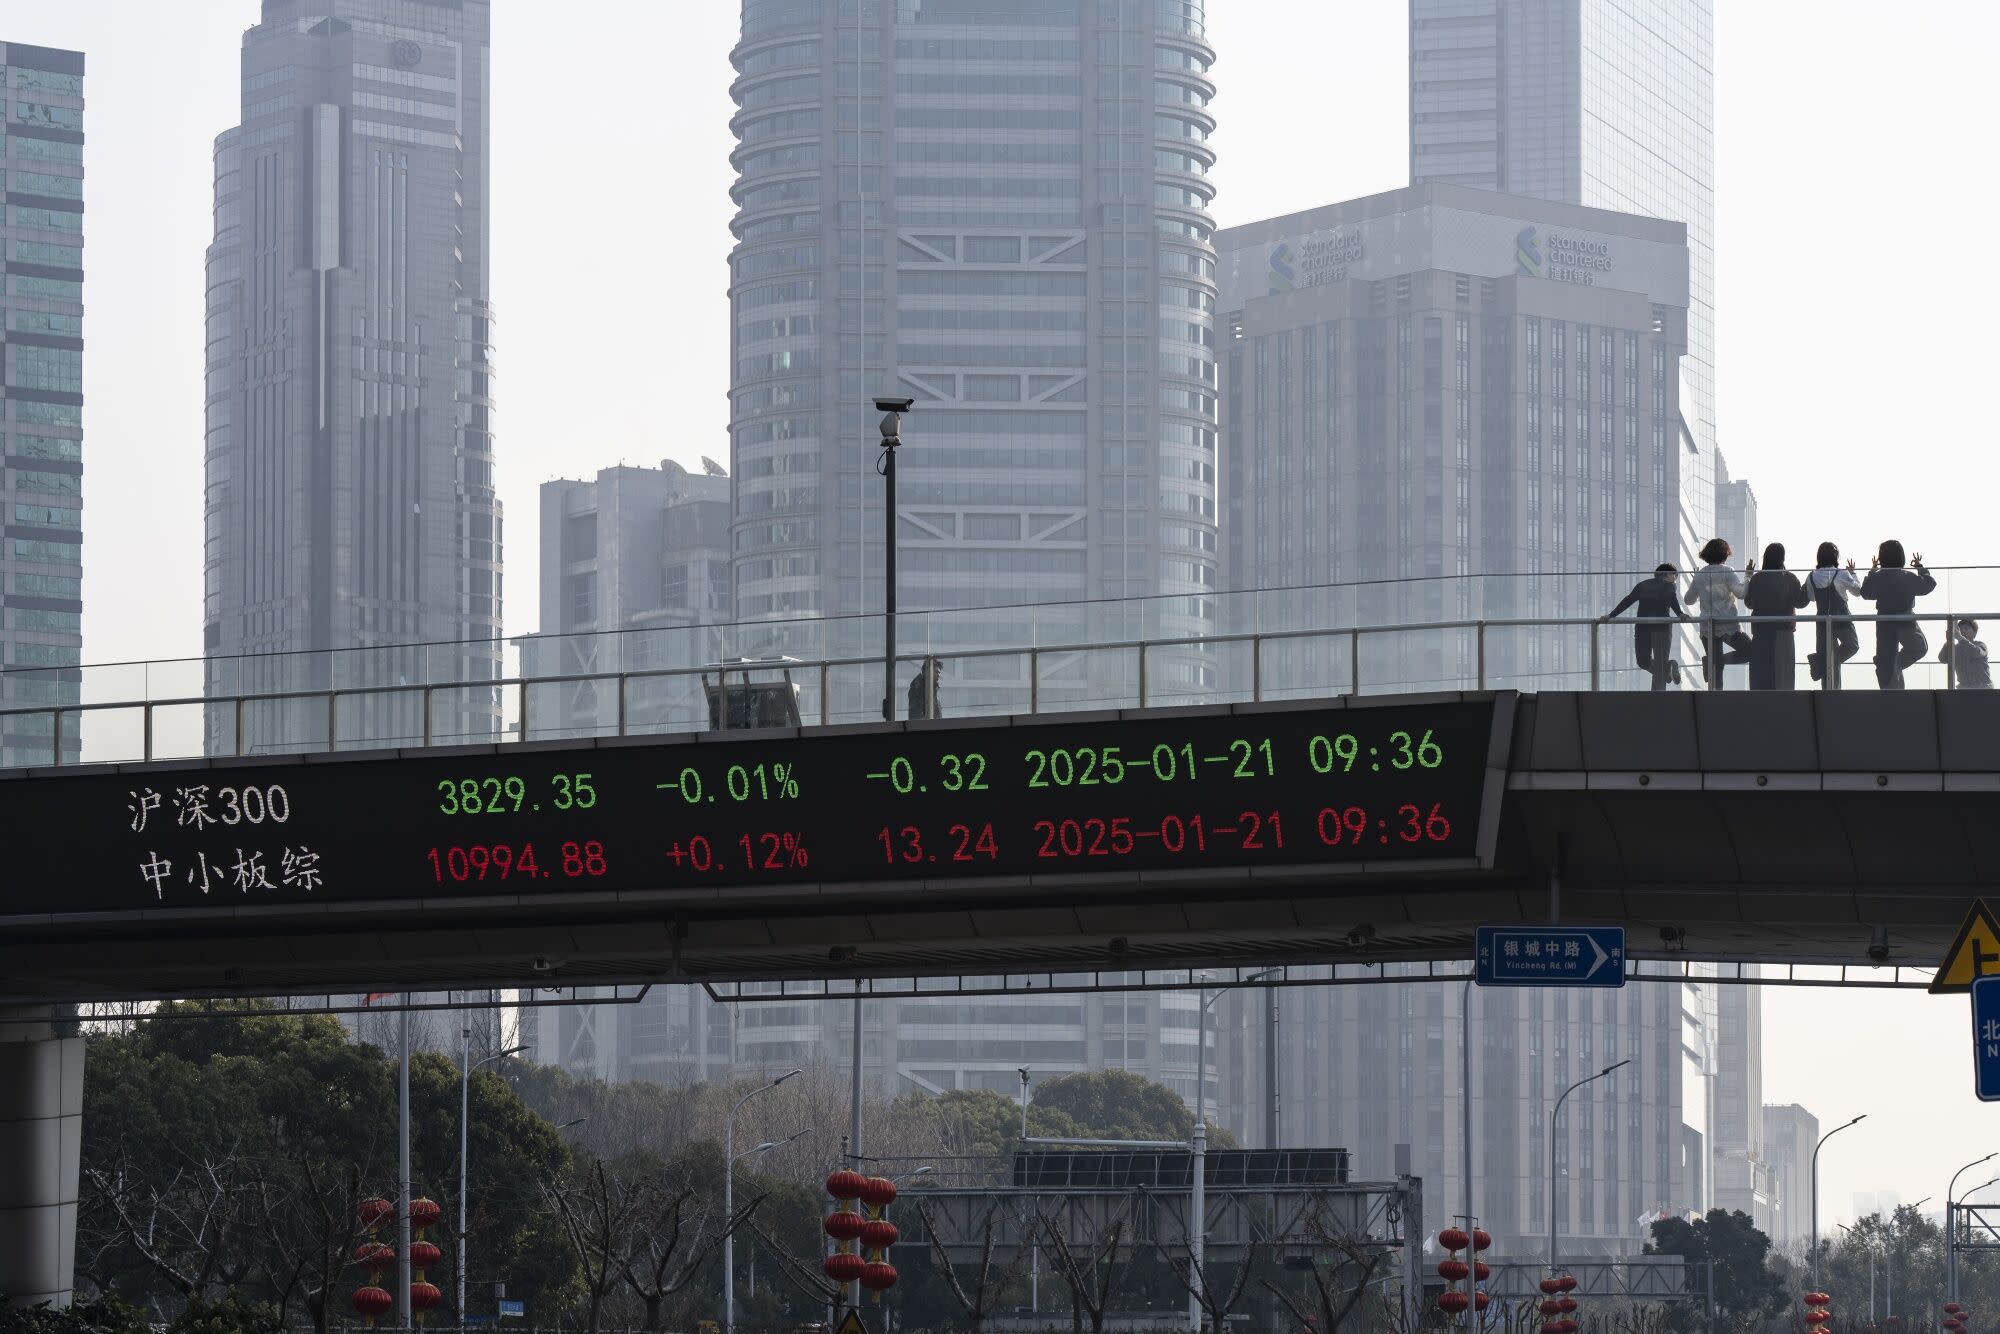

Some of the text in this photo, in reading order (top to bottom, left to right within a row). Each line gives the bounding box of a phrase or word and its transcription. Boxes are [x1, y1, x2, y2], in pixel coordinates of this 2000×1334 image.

[1024, 738, 1276, 789] 2025-01-21
[1309, 729, 1444, 774] 09:36
[140, 846, 324, 900] 中小板综
[1034, 810, 1286, 859] 2025-01-21
[1318, 803, 1452, 846] 09:36
[1480, 947, 1489, 957] 北
[1504, 940, 1581, 957] 银城中路
[1611, 948, 1621, 958] 南
[1506, 961, 1546, 971] Yincheng
[1564, 961, 1577, 970] (M)
[1612, 959, 1619, 967] S
[1982, 1019, 2000, 1041] 北
[1987, 1044, 1999, 1058] N
